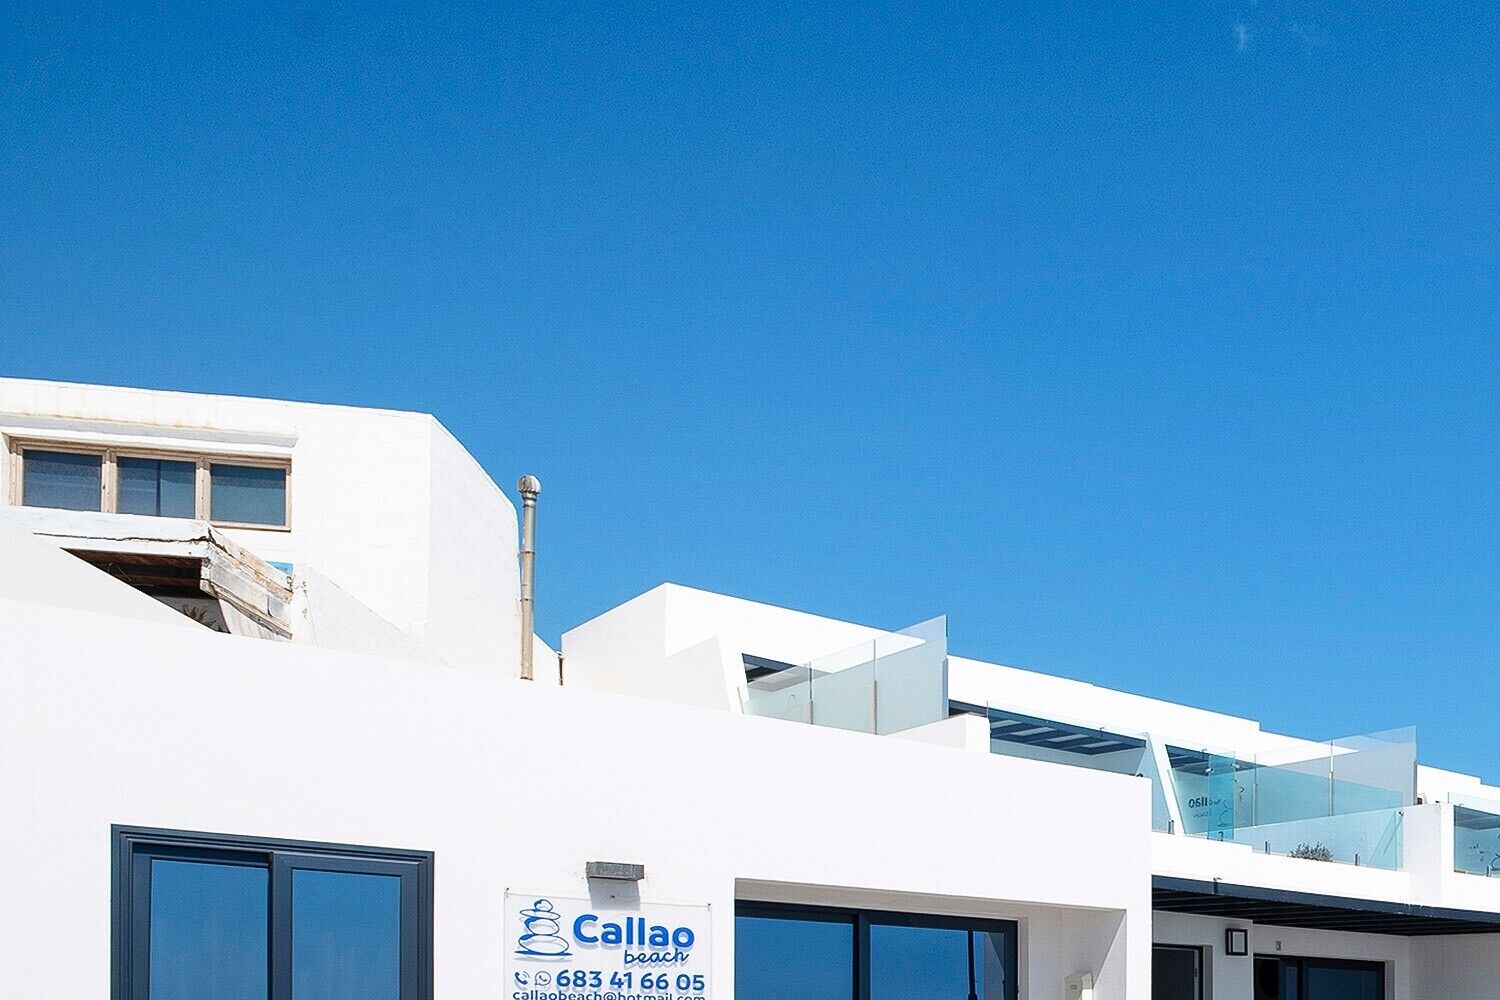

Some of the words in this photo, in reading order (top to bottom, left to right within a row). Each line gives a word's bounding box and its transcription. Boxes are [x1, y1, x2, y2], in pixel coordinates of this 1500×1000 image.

[573, 914, 695, 948] Callao
[624, 948, 690, 964] beach
[556, 969, 602, 988] 683
[609, 971, 633, 989] 41
[640, 973, 669, 990] 66
[676, 974, 705, 991] 05
